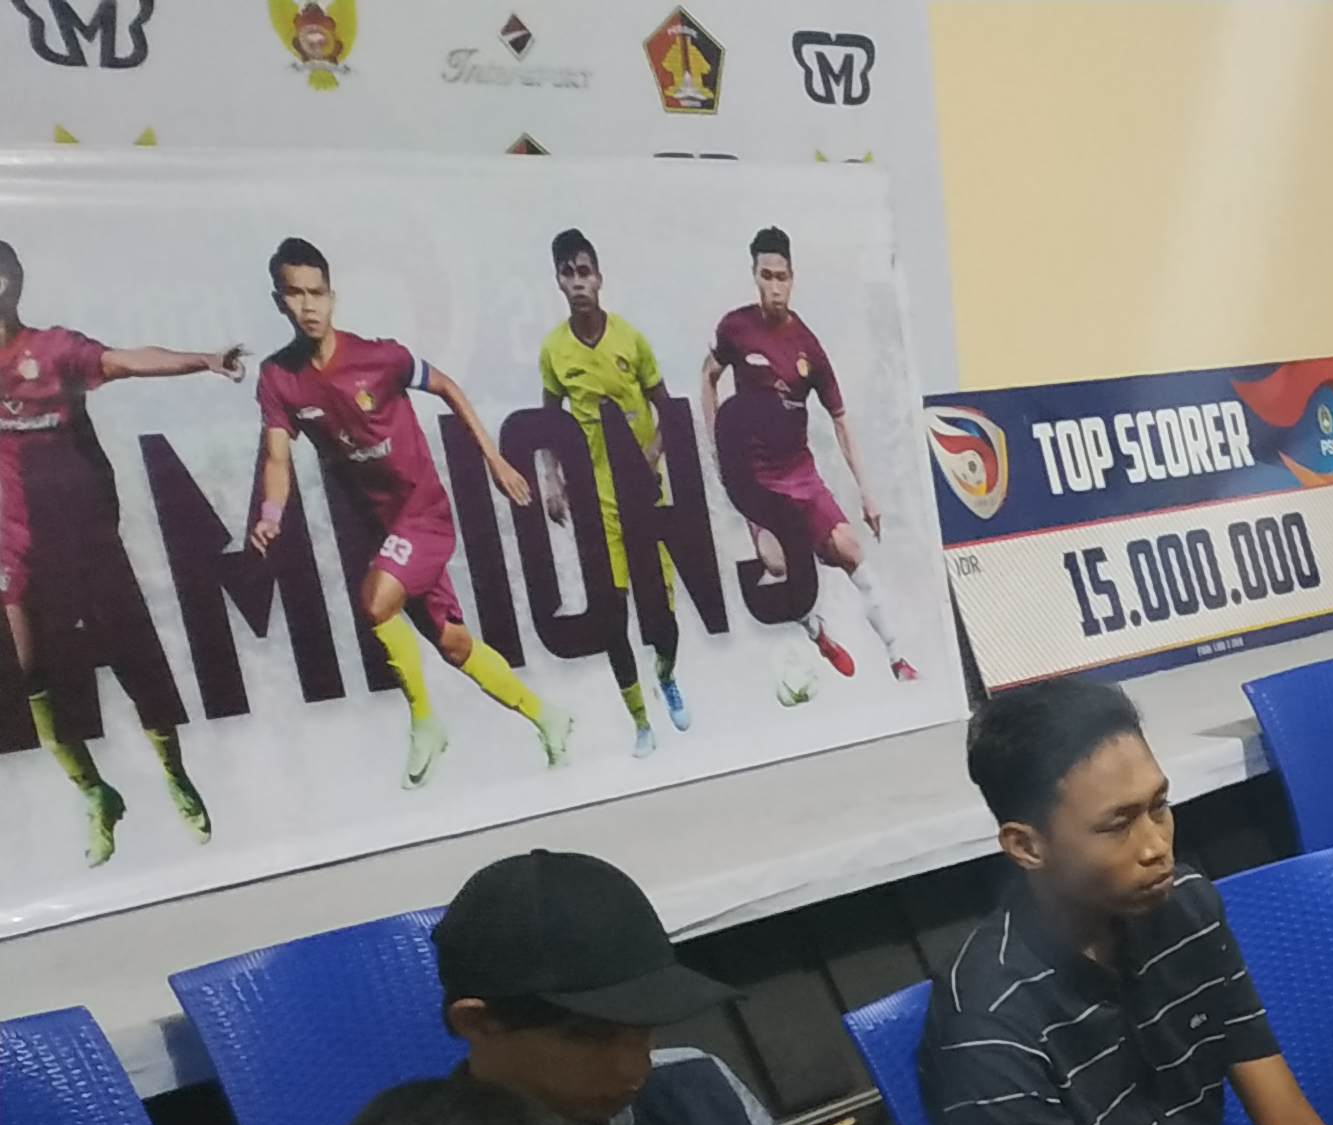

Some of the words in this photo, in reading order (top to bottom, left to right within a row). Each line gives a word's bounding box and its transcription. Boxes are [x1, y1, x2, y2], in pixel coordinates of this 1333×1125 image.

[1032, 416, 1114, 496] TOP
[1114, 400, 1256, 484] SCORER
[379, 533, 413, 567] 93
[955, 553, 982, 577] IDR
[1062, 511, 1322, 638] 15.000.000
